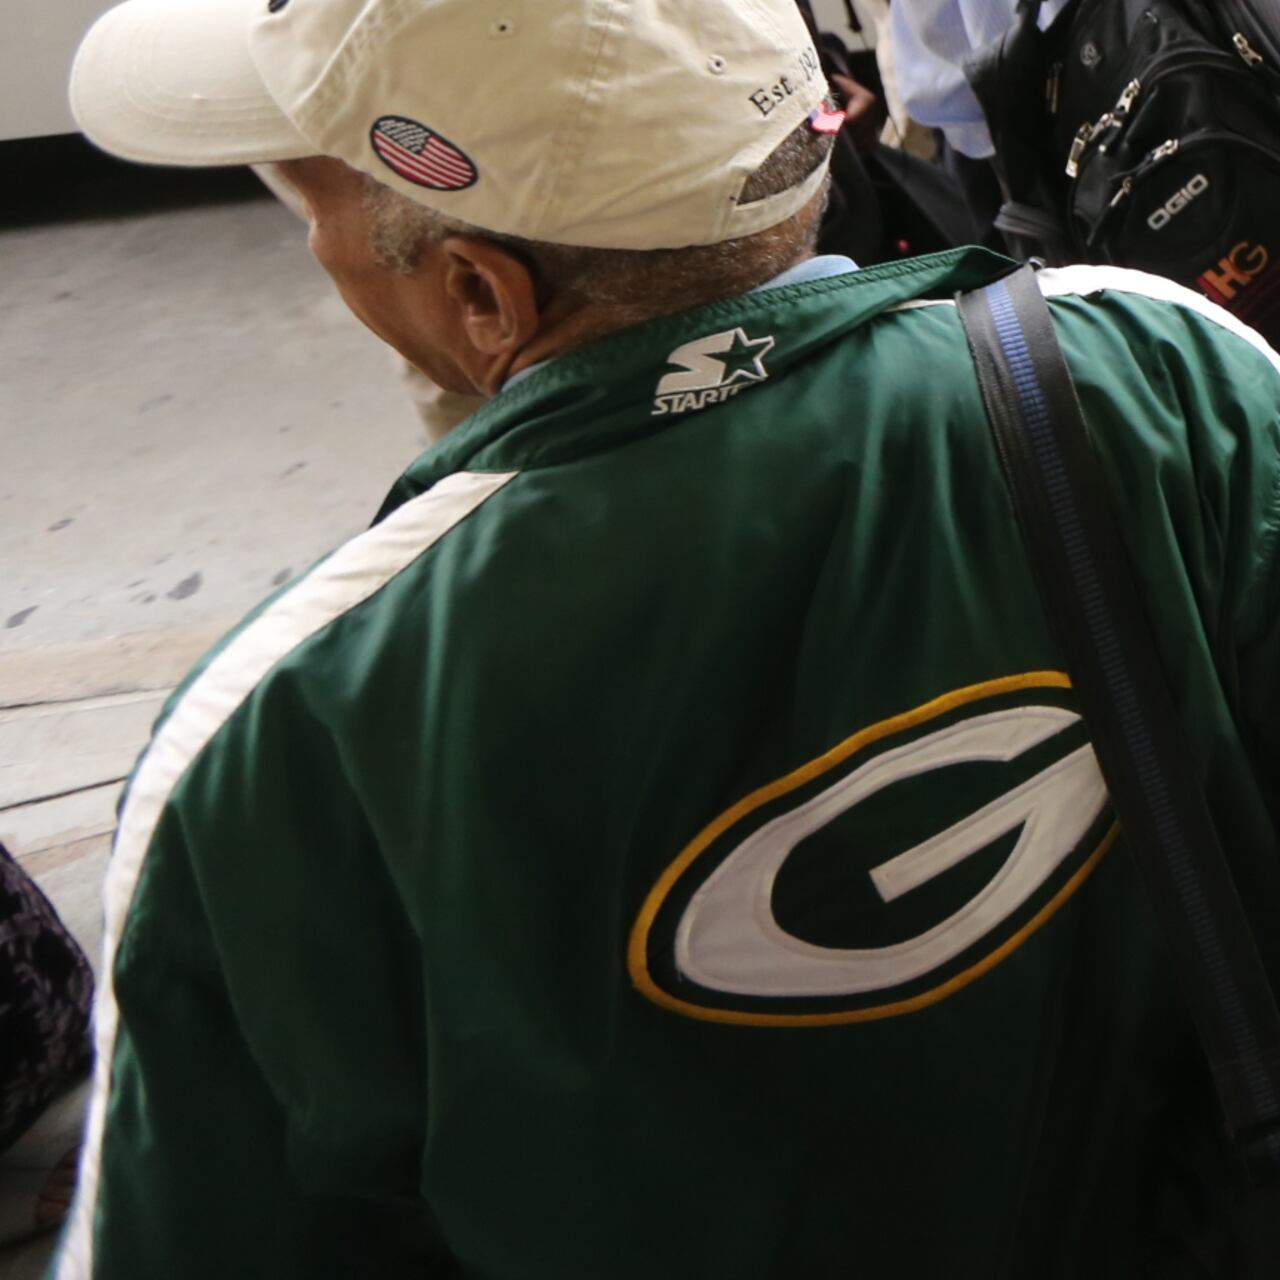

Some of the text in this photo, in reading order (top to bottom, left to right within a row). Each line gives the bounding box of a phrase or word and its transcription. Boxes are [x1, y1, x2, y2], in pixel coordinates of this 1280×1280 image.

[1147, 173, 1209, 230] OGIO
[651, 380, 758, 415] START
[675, 705, 1108, 997] G
